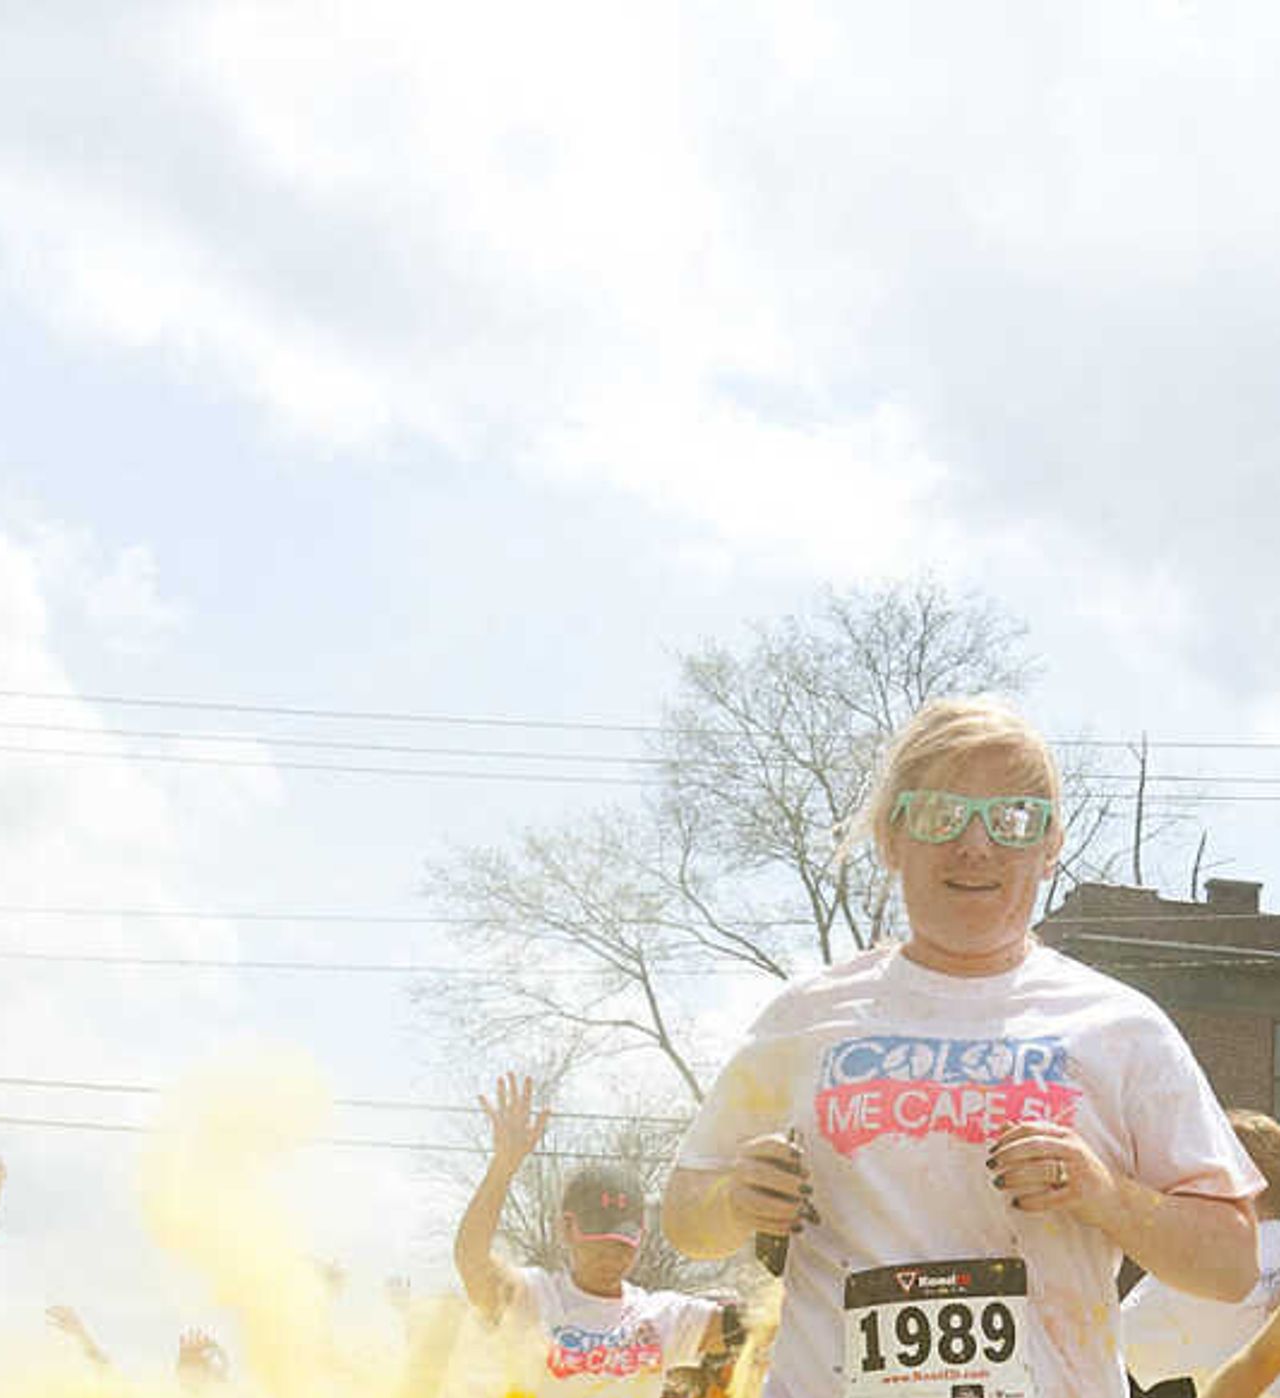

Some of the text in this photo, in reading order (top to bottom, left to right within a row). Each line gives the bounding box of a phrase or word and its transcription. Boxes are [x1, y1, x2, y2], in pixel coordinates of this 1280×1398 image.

[832, 1041, 1054, 1091] COLOR
[827, 1092, 881, 1134] ME
[893, 1090, 1007, 1131] CAPE
[861, 1302, 1016, 1372] 1989
